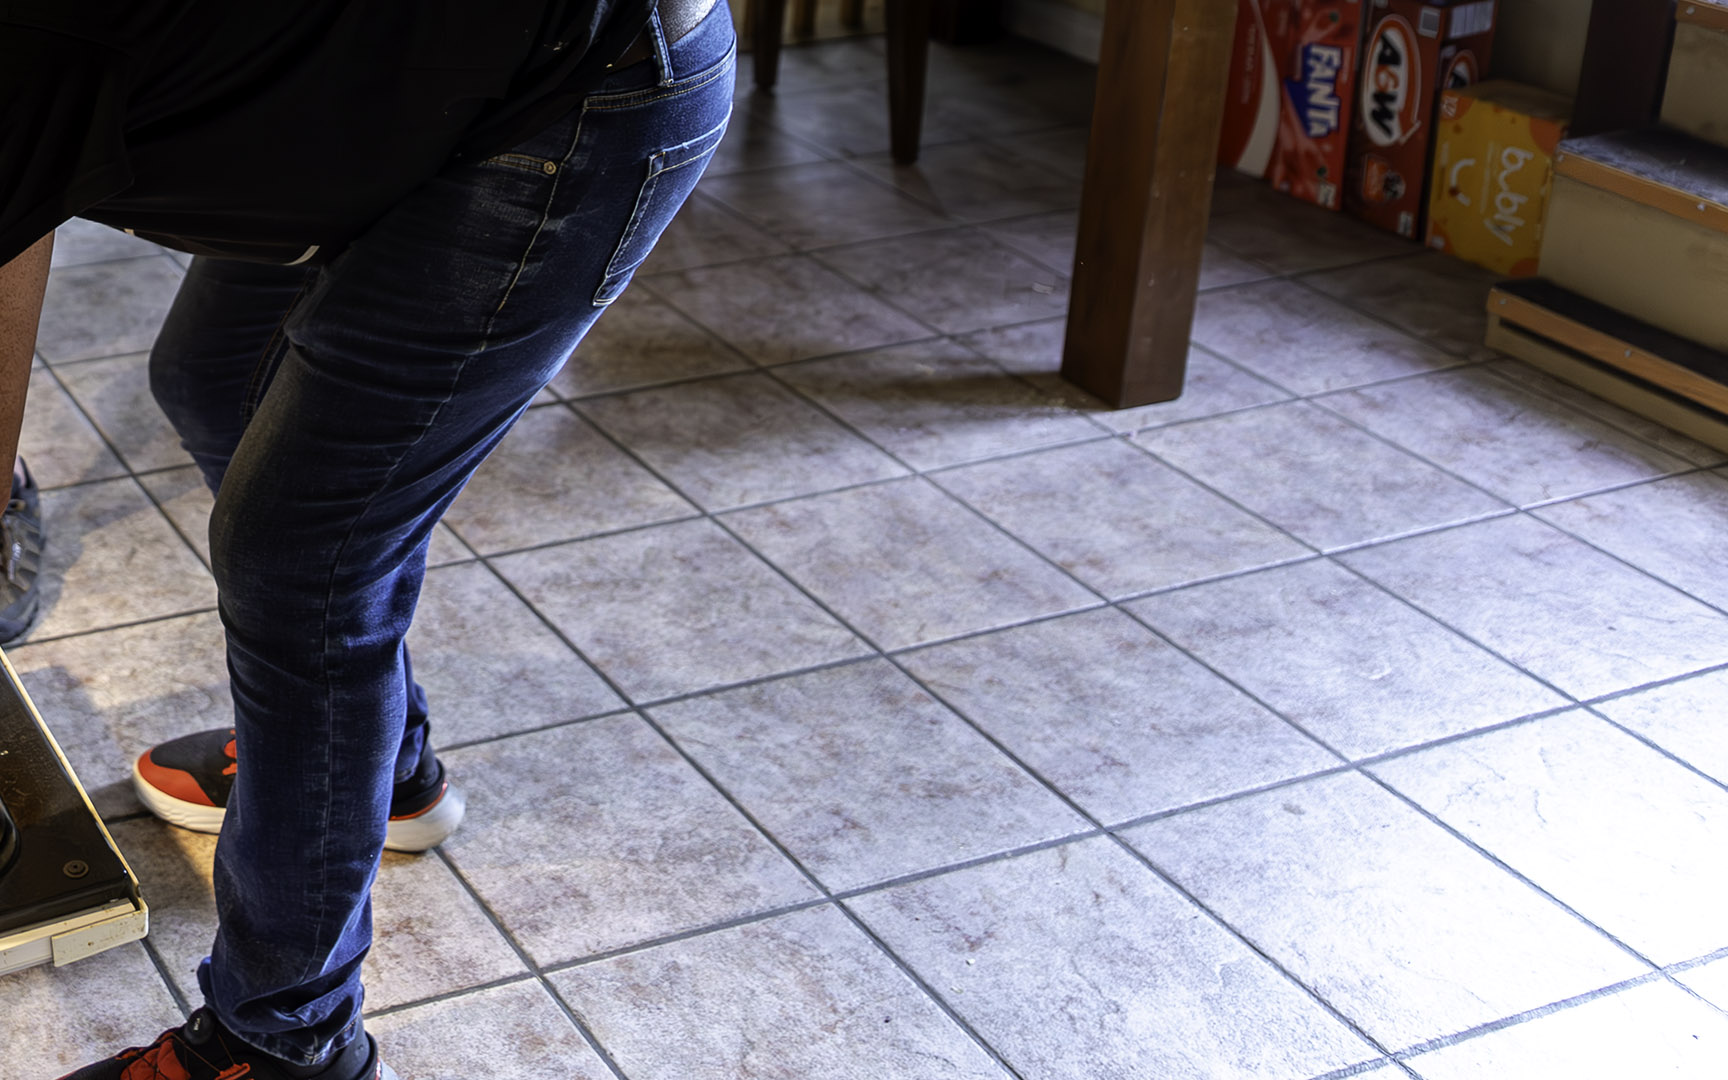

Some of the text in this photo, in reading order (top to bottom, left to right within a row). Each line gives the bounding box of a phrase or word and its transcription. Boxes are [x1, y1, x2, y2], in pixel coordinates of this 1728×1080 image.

[1306, 46, 1342, 137] FANTA
[1371, 32, 1402, 138] A&W
[1483, 146, 1535, 247] bubly
